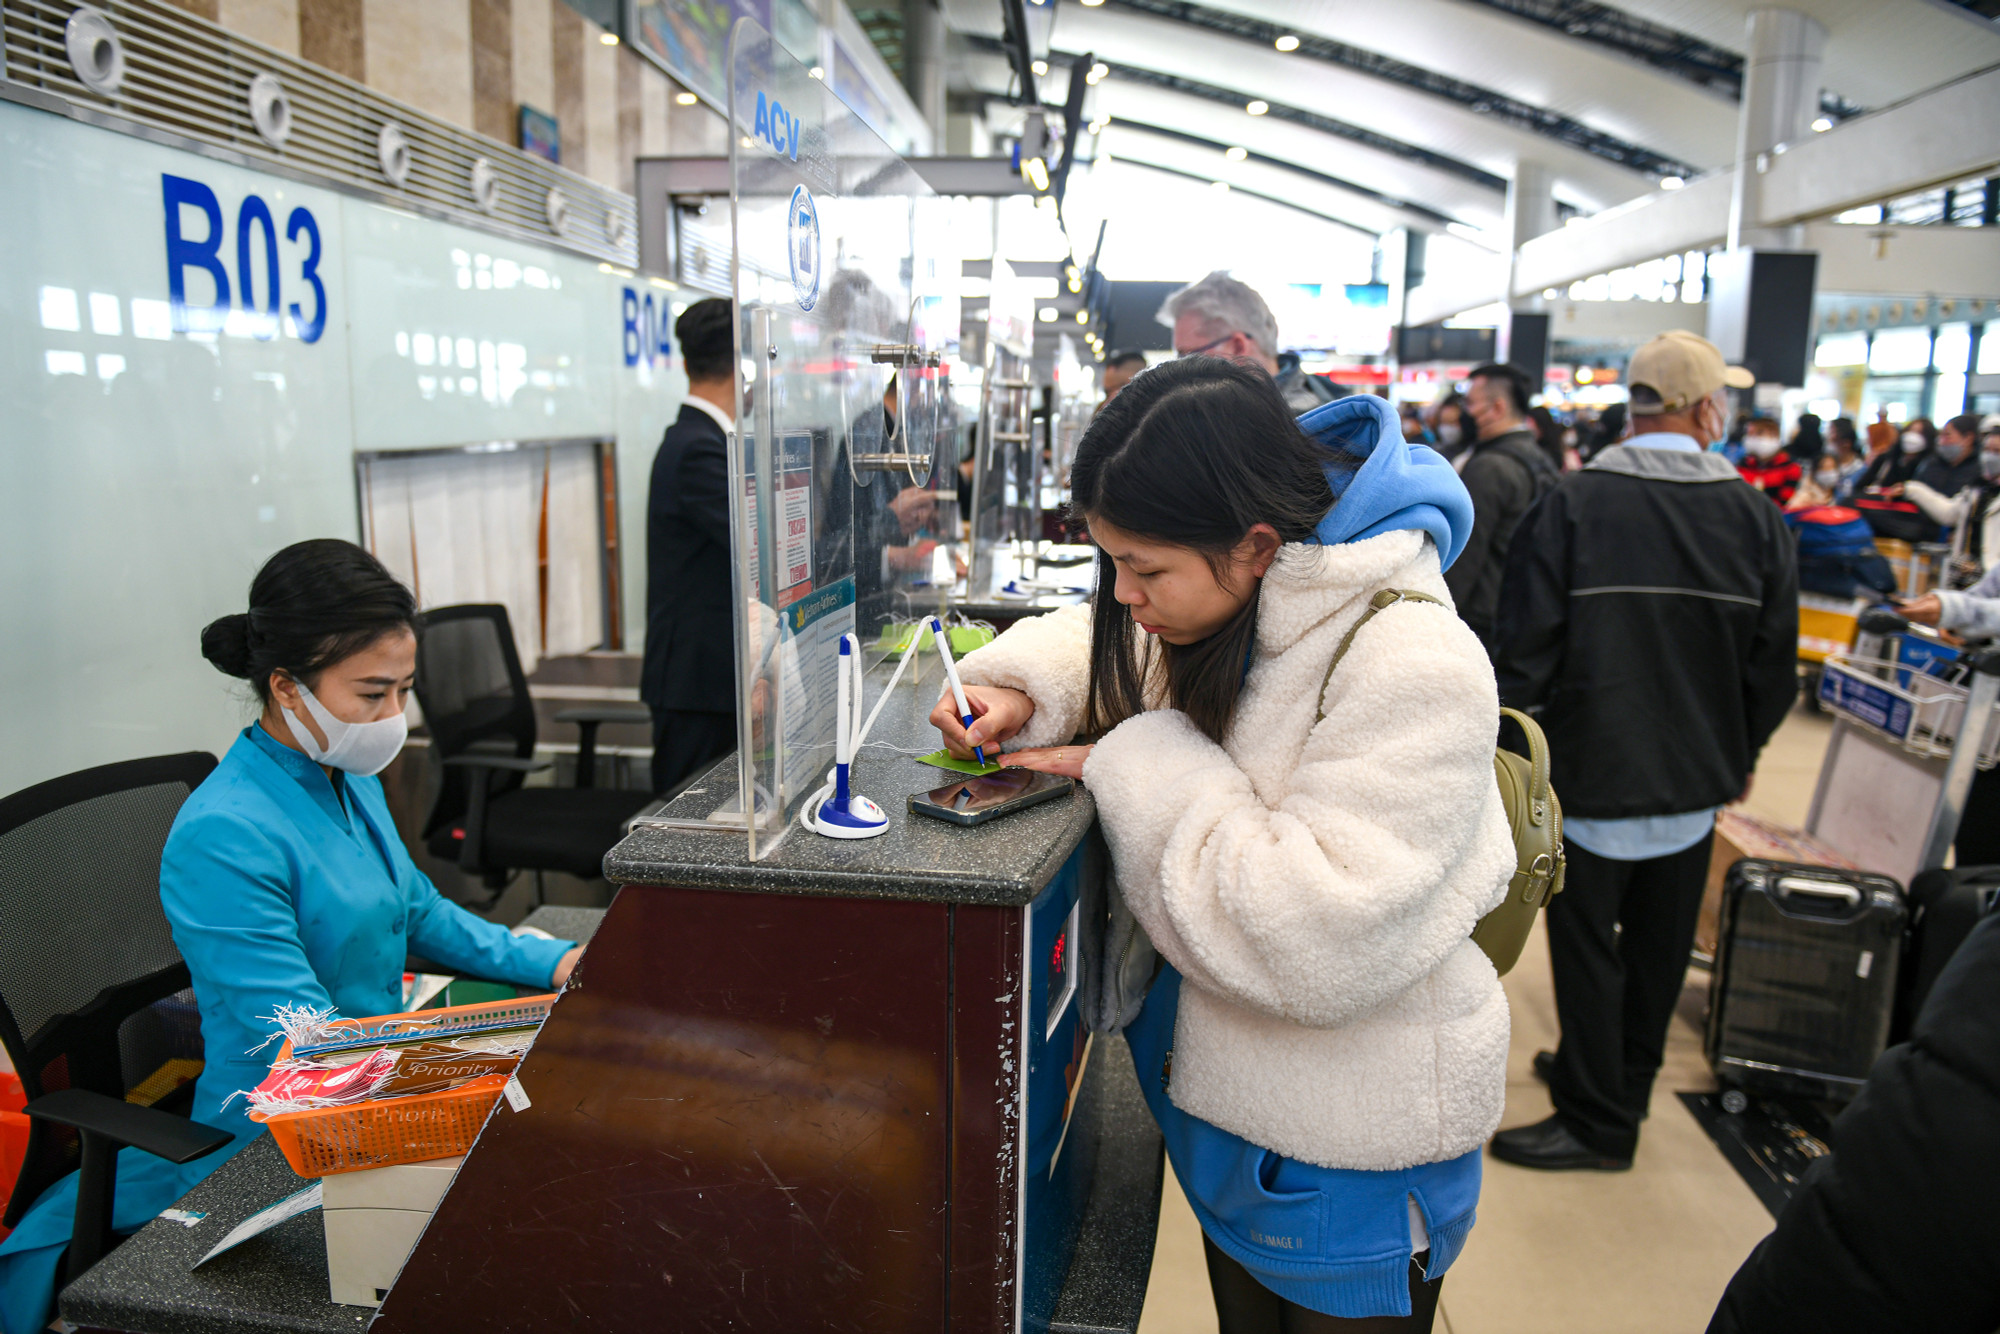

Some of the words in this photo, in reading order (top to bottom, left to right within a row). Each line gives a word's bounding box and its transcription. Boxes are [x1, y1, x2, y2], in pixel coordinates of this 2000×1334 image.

[754, 90, 799, 162] ACV
[162, 173, 327, 344] B03
[623, 286, 671, 371] B04
[411, 1063, 497, 1077] Priority
